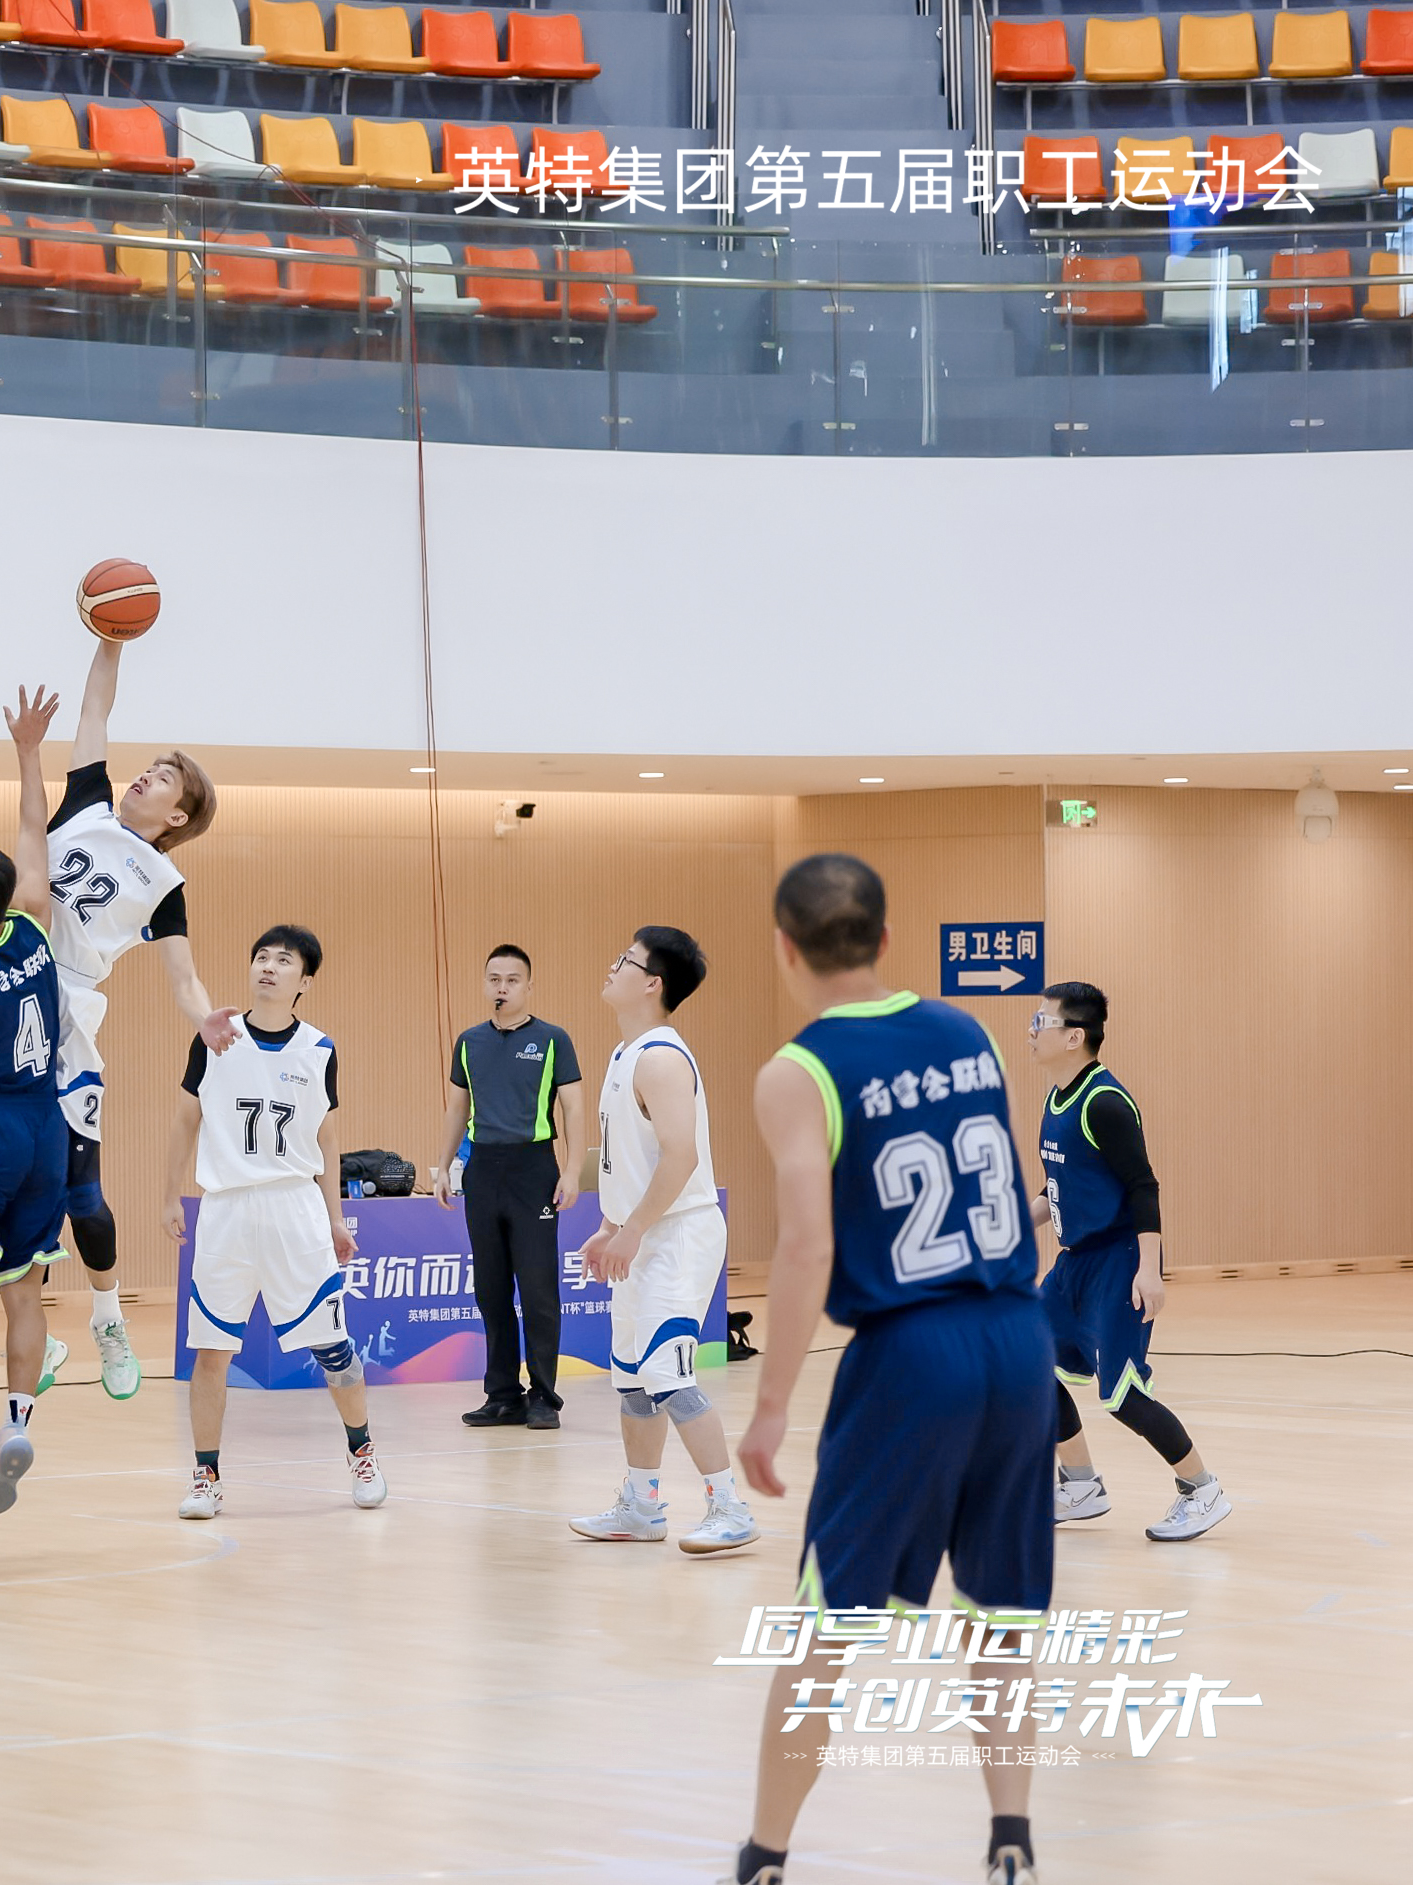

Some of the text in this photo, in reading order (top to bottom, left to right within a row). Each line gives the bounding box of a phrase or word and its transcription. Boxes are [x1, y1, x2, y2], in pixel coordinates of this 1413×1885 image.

[49, 848, 120, 926] 22
[948, 930, 1037, 962] 男卫生间
[13, 993, 51, 1078] 4
[83, 1092, 99, 1128] 2
[235, 1097, 295, 1157] 77
[872, 1113, 1022, 1284] 23
[326, 1297, 342, 1331] 7
